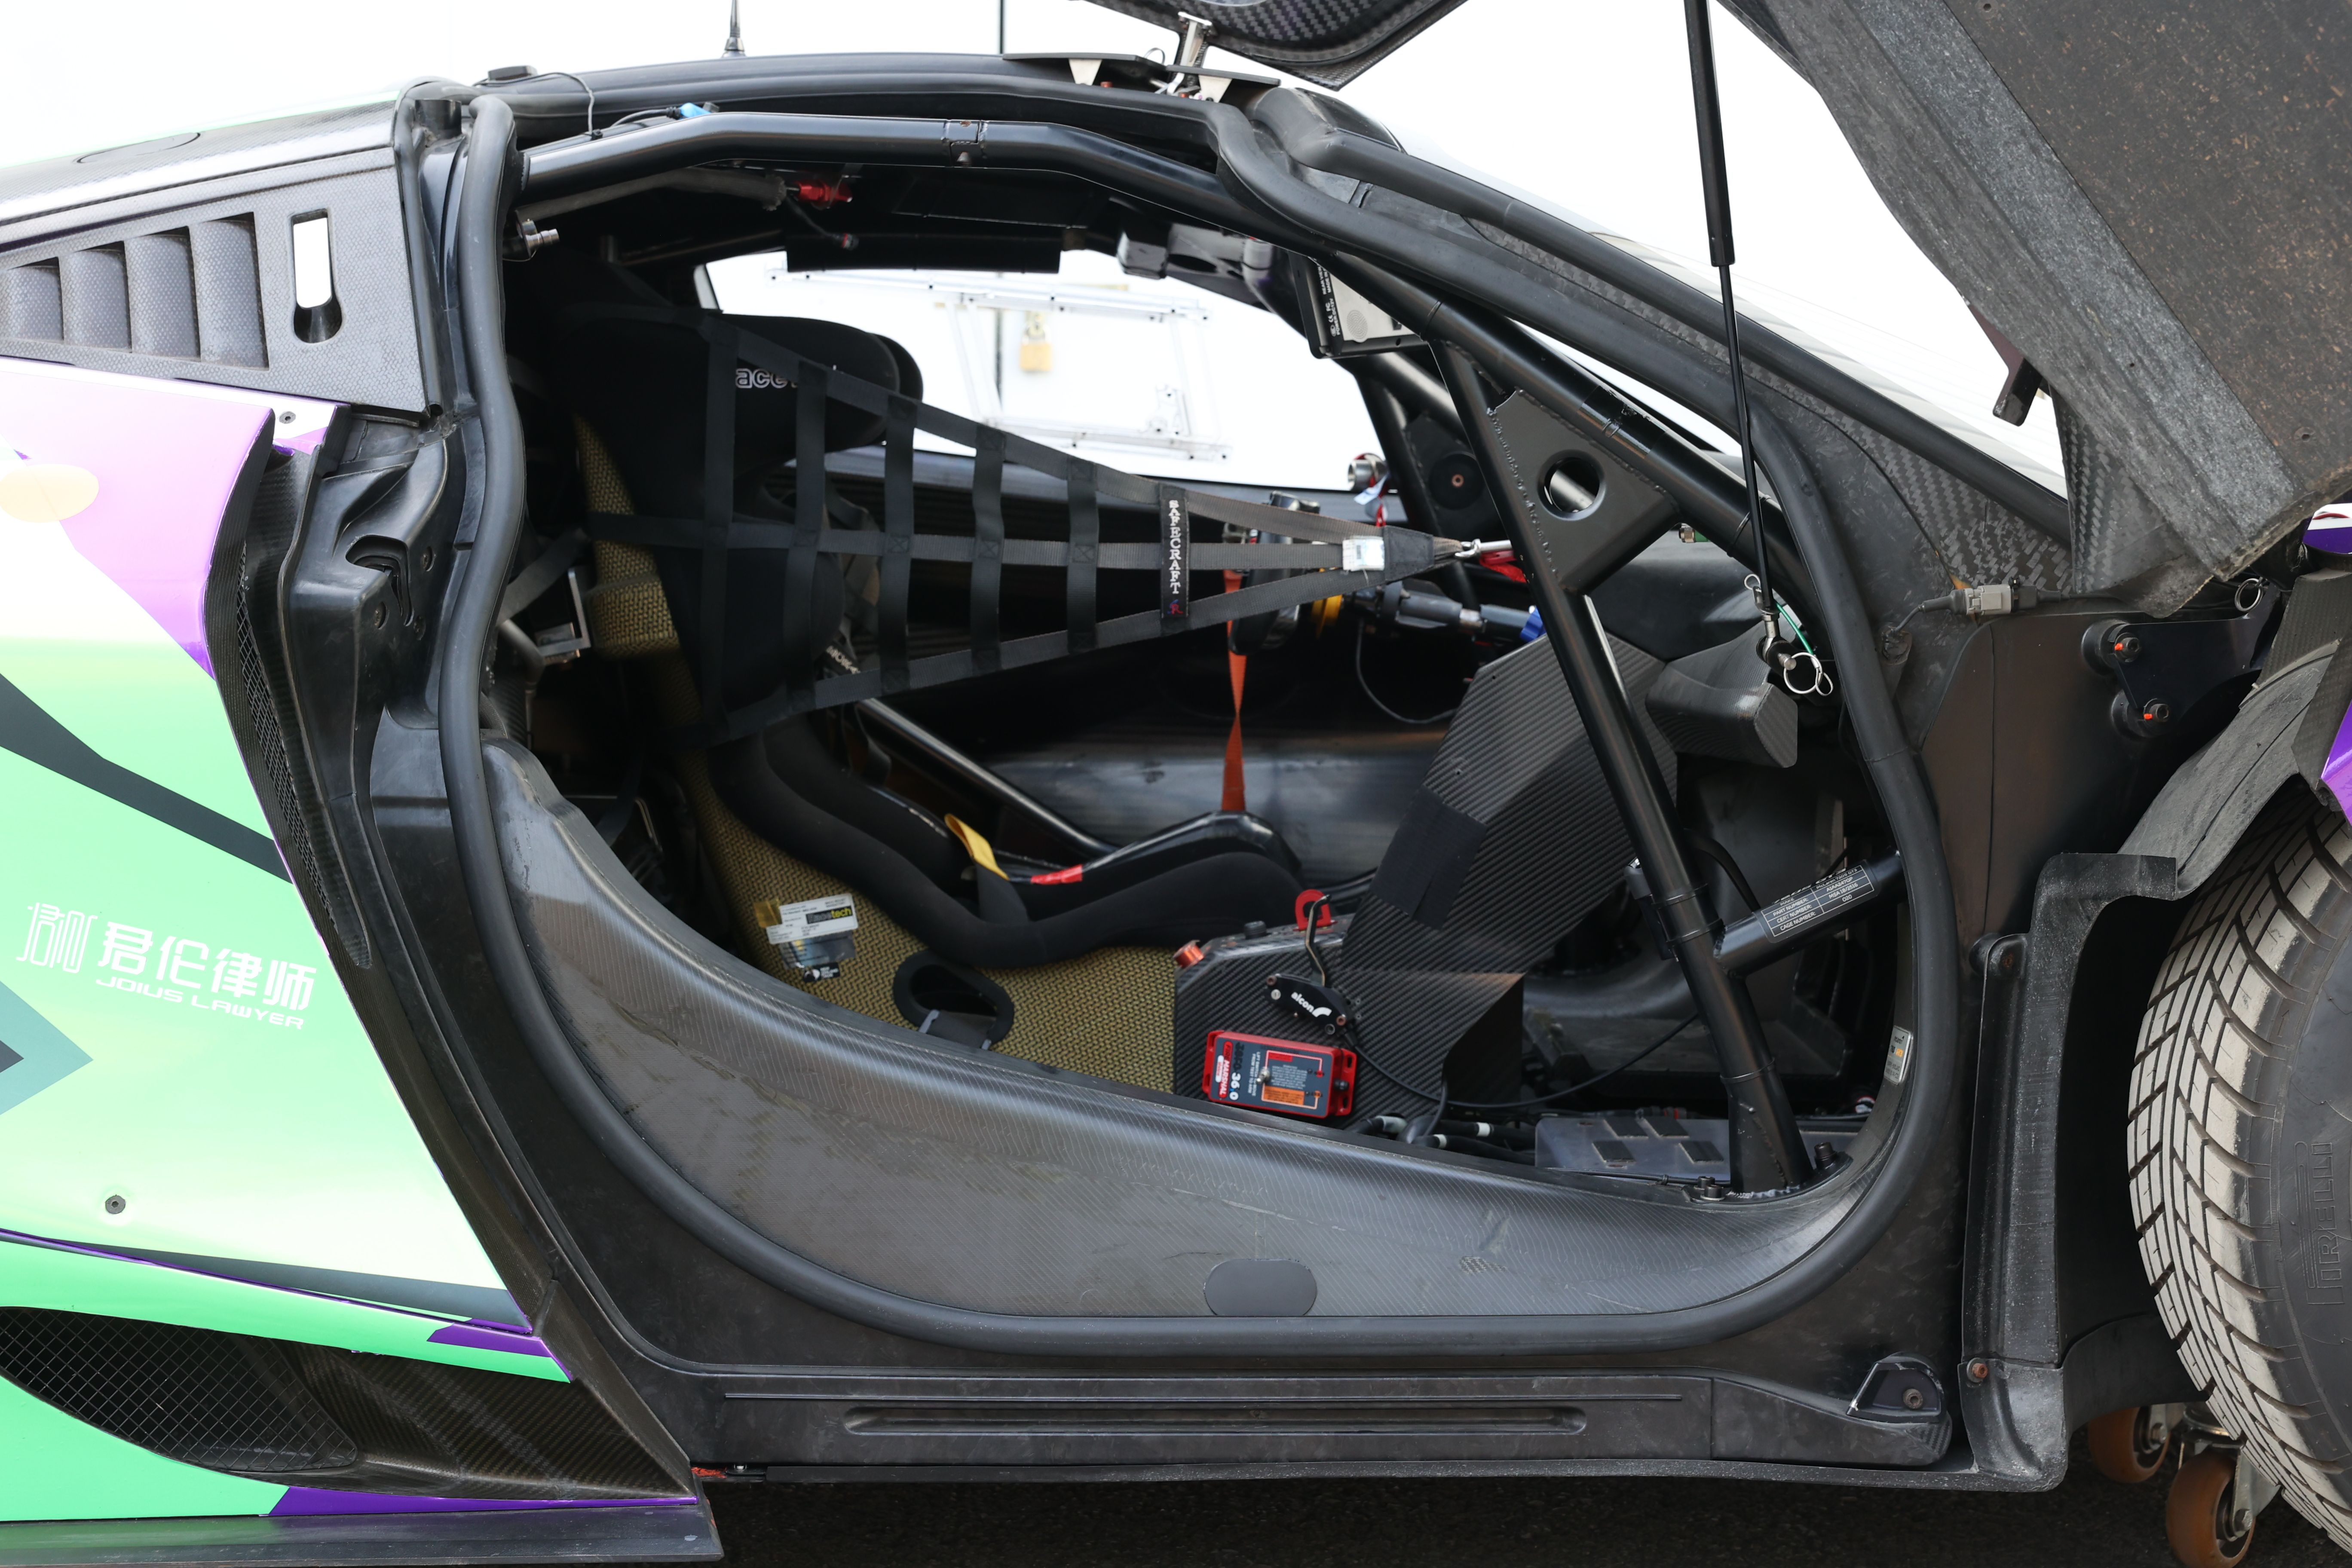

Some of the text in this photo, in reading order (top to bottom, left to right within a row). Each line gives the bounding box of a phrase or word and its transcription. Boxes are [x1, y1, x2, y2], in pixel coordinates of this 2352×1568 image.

[1168, 499, 1181, 594] SAFECRAFT
[1816, 878, 1835, 889] McLaren
[1835, 873, 1848, 881] 720S
[1828, 882, 1859, 899] MSA 18/2516
[1773, 897, 1809, 917] PART NUMBER:
[1780, 897, 1795, 906] MAKE
[1842, 894, 1853, 902] 020
[1776, 904, 1813, 924] CERT NUMBER:
[1780, 911, 1816, 931] CAGE NUMBER:
[98, 921, 317, 1011] 君伦律师
[95, 976, 304, 1030] JOIUS LAWYER
[1291, 991, 1314, 1013] alcon
[1219, 1060, 1231, 1096] MARSHAL
[2294, 1141, 2345, 1305] PIRELLI
